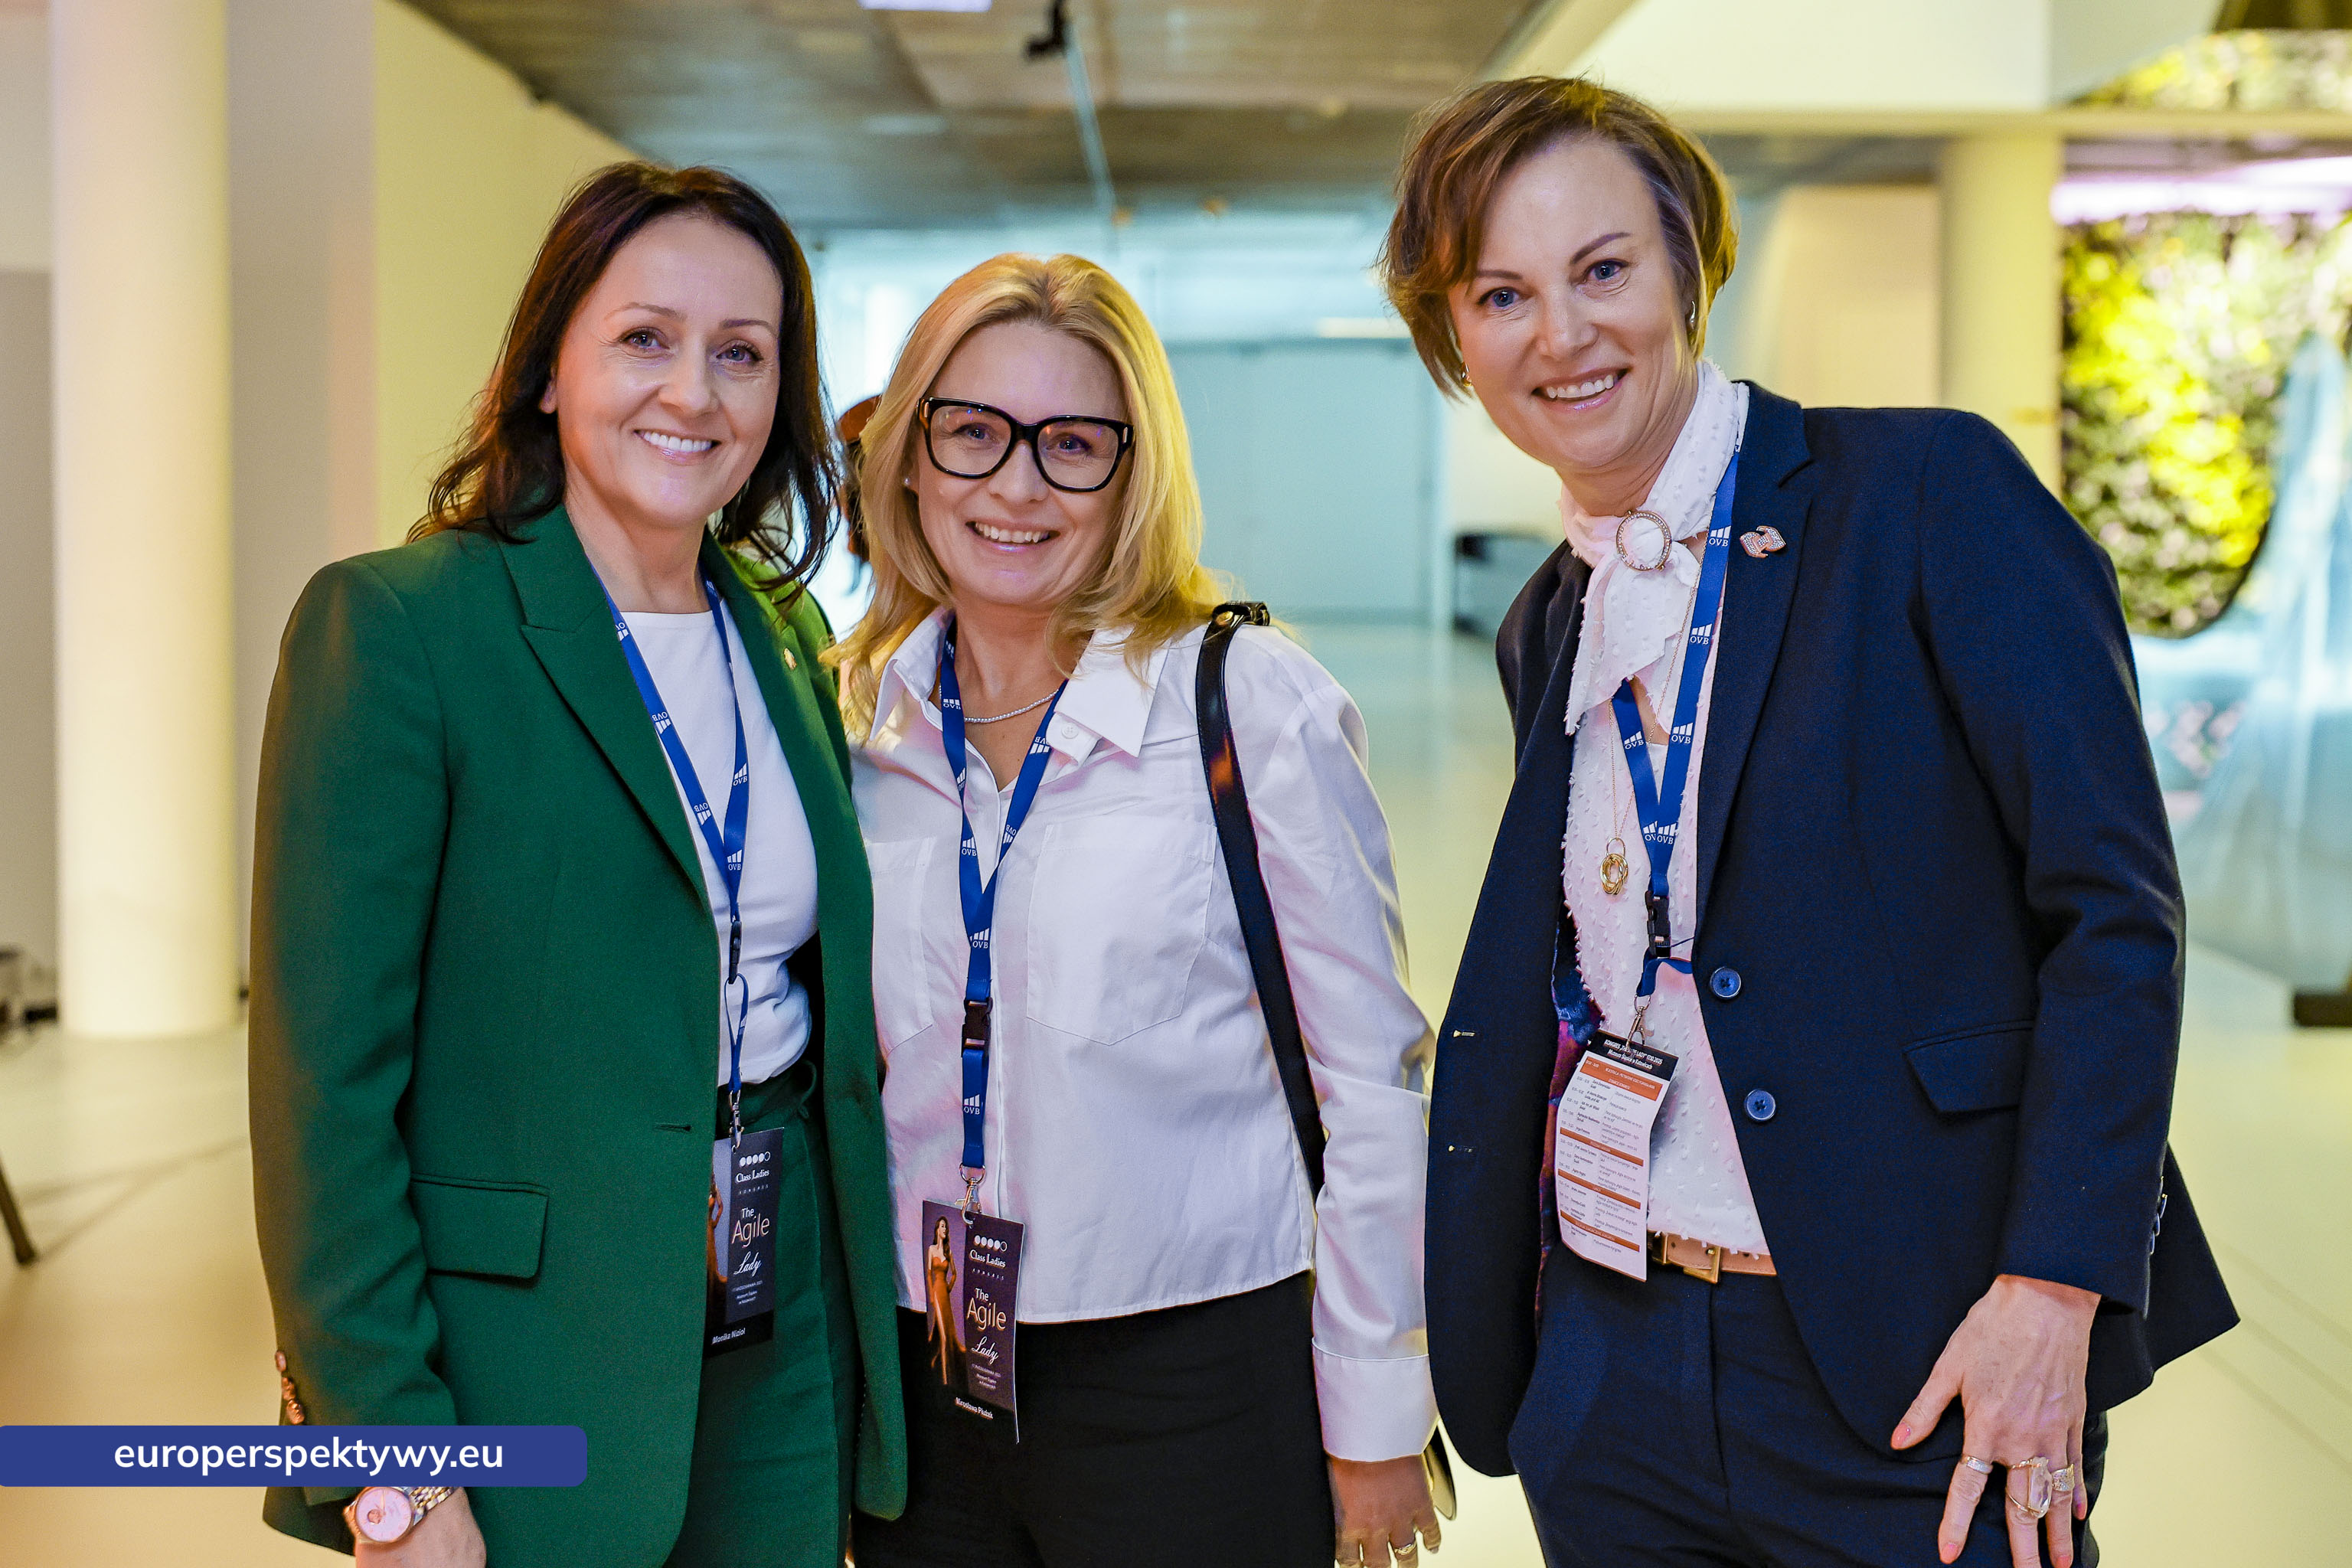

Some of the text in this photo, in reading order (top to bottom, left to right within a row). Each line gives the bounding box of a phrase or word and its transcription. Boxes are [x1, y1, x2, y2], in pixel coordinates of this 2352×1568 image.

[1708, 537, 1730, 547] OVB
[1690, 635, 1710, 645] OVB
[652, 710, 668, 722] OVB
[1624, 737, 1645, 750] OVB
[1671, 733, 1691, 744] OVB
[733, 775, 748, 786] OVB
[694, 802, 709, 812] OVB
[1006, 824, 1017, 836] OVB
[1644, 831, 1657, 841] OV
[1656, 834, 1675, 844] OVB
[962, 848, 978, 857] OVB
[727, 863, 742, 871] OVB
[972, 940, 988, 949] OVB
[964, 1106, 980, 1115] OVB
[736, 1168, 769, 1183] Class Ladies
[741, 1207, 754, 1219] The
[731, 1214, 770, 1248] Agile
[733, 1250, 763, 1276] Lady
[969, 1249, 1006, 1269] Class Ladies
[975, 1287, 989, 1302] The
[967, 1297, 1007, 1331] Agile
[711, 1331, 731, 1344] Monika
[971, 1335, 999, 1365] Lady
